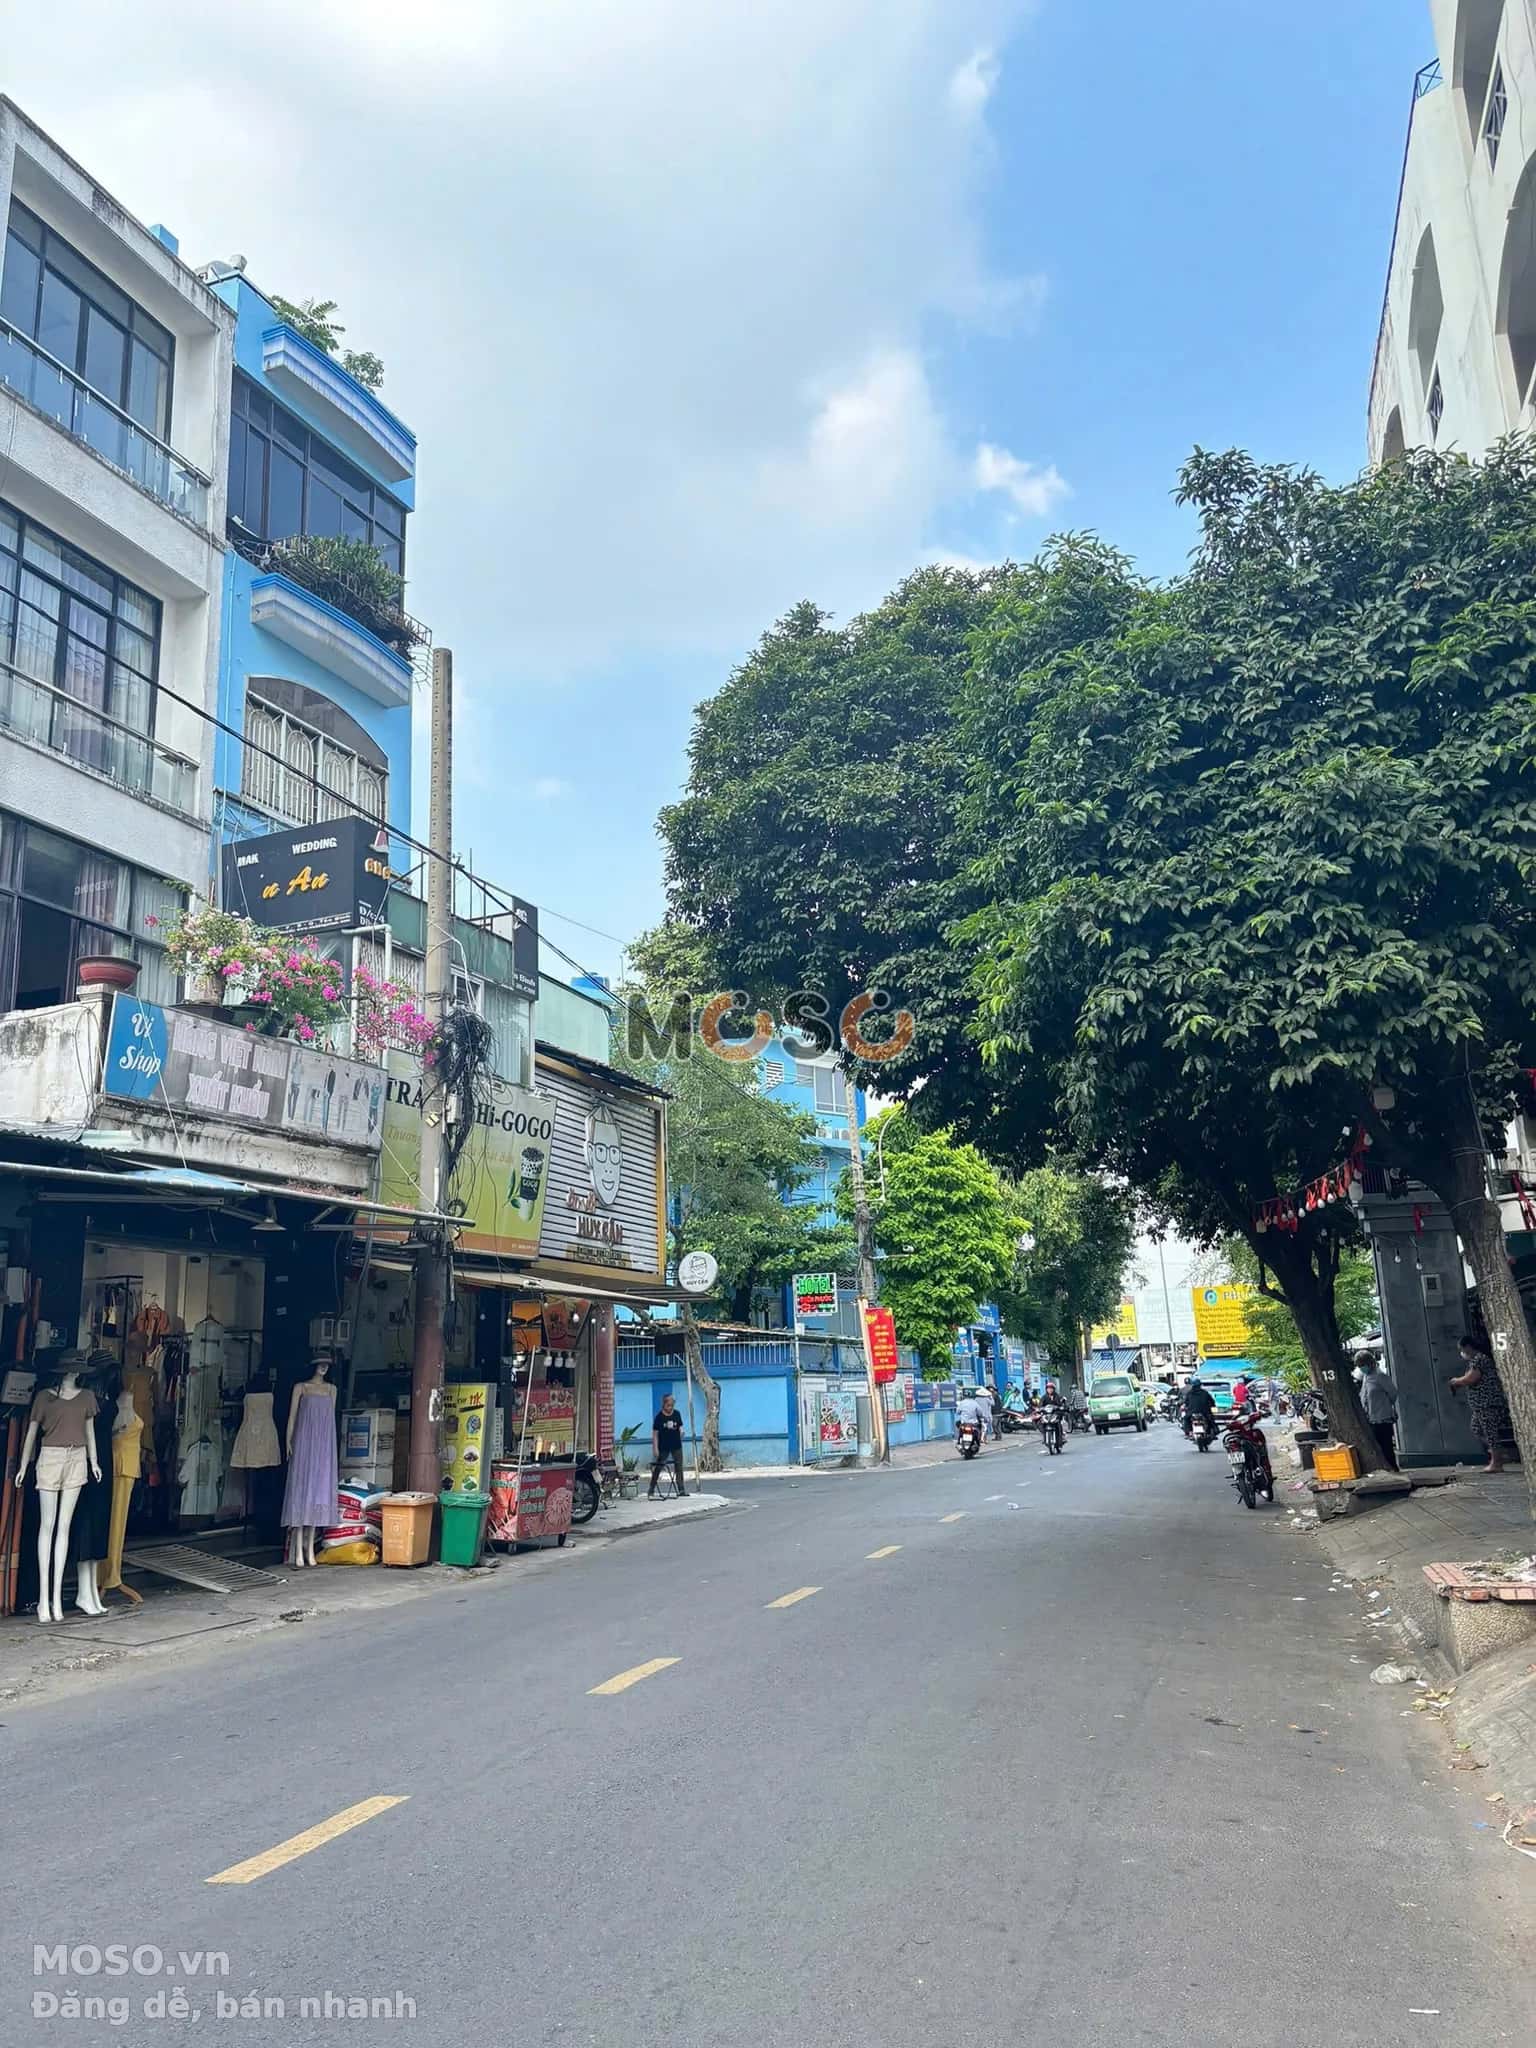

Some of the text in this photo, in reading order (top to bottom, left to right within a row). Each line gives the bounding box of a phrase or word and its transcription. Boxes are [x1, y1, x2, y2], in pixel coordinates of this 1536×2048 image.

[291, 837, 338, 855] WEDDING
[131, 1012, 155, 1038] Vi
[119, 1045, 161, 1079] Shop
[185, 1070, 270, 1120] XUẤT KHẨU
[386, 1077, 423, 1109] TRÀ
[799, 1277, 833, 1295] HOTEL
[1491, 1332, 1508, 1350] 15
[1321, 1369, 1336, 1382] 13
